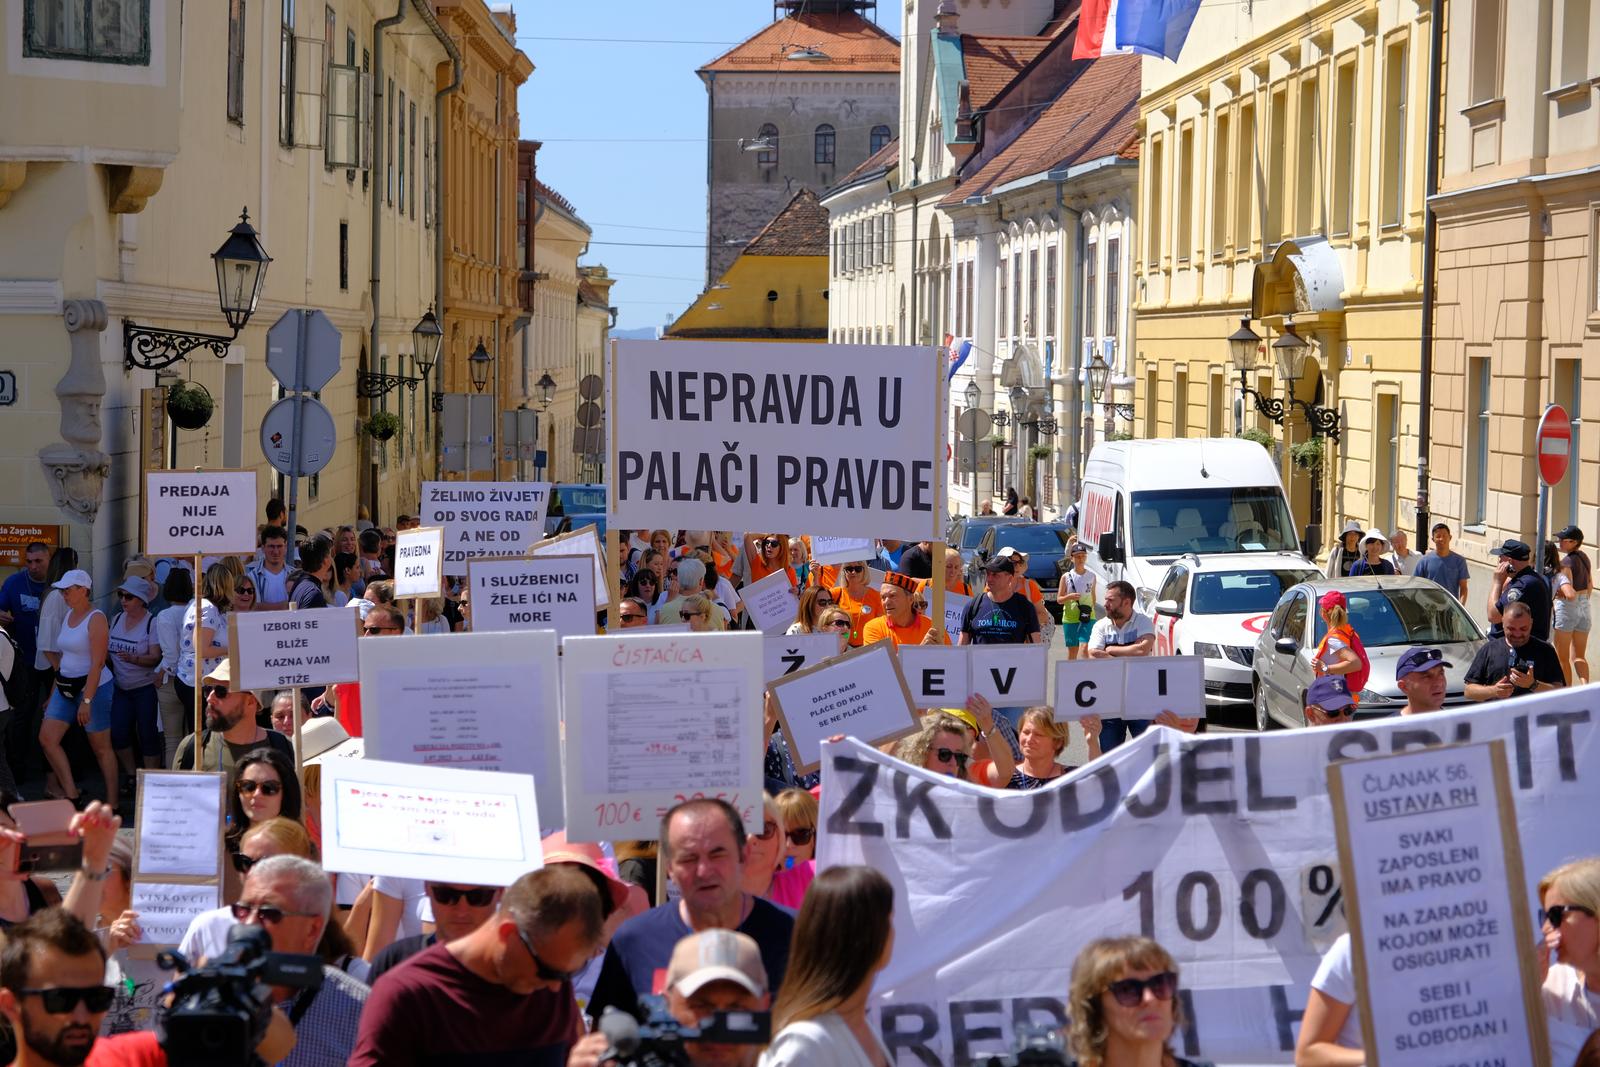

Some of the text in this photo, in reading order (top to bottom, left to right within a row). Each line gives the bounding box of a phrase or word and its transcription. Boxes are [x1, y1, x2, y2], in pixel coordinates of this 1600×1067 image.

[650, 371, 902, 428] NEPRAVDA U
[619, 442, 932, 511] PALAČI PRAVDE
[160, 485, 229, 497] PREDAJA
[431, 488, 544, 502] ŽELIMO ŽIVJETI
[183, 505, 217, 516] NIJE
[434, 511, 538, 522] OD SVOG RADA
[10, 526, 42, 536] Zagreba
[169, 525, 224, 537] OPCIJA
[460, 530, 520, 542] A NE OD
[400, 545, 431, 558] PRAVEDNA
[481, 573, 579, 587] I SLUŽBENICI
[491, 592, 577, 605] ŽELE IĆI NA
[263, 620, 318, 631] IZBORI SE
[509, 612, 551, 623] MORE
[277, 638, 308, 649] BLIŽE
[265, 656, 330, 667] KAZNA VAM
[612, 643, 704, 667] ČISTAČICA
[278, 674, 310, 684] STIŽE
[922, 667, 1017, 696] E V
[1074, 669, 1168, 708] C I
[812, 682, 856, 703] DAJTE NAM
[836, 699, 848, 707] OD
[849, 689, 874, 703] KOJIH
[818, 719, 829, 727] SE
[830, 714, 841, 723] NE
[978, 737, 1297, 839] ODJEL
[1362, 768, 1442, 794] ČLANAK
[1364, 786, 1478, 819] USTAVA RH
[1399, 828, 1453, 849] SVAKI
[1379, 847, 1479, 874] ZAPOSLENI
[1382, 868, 1481, 896] IMA PRAVO
[1123, 865, 1345, 941] 100%
[1384, 900, 1488, 930] NA ZARADU
[1379, 919, 1499, 952] KOJOM MOŽE
[1393, 943, 1491, 972] OSIGURATI
[1420, 981, 1471, 1003] SEBI I
[1408, 999, 1488, 1027] OBITELJI
[1395, 1019, 1508, 1051] SLOBODAN I
